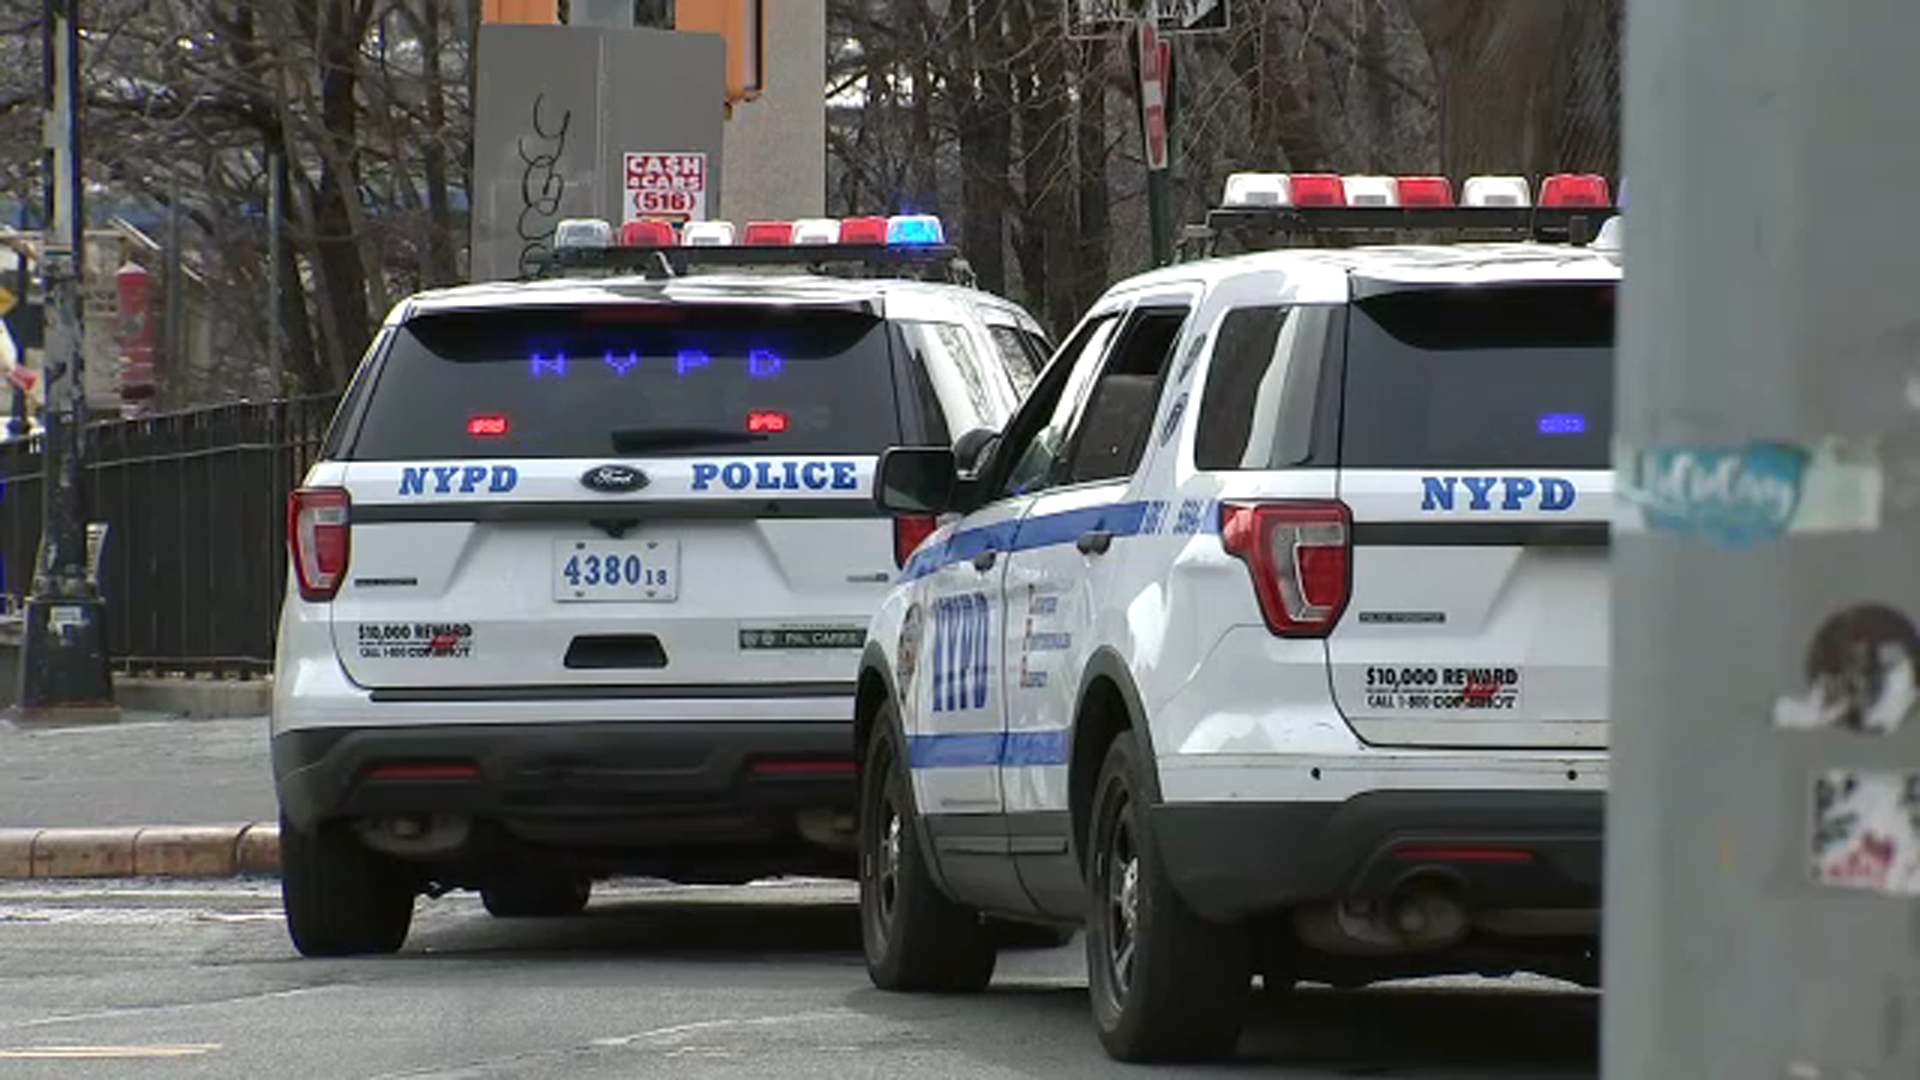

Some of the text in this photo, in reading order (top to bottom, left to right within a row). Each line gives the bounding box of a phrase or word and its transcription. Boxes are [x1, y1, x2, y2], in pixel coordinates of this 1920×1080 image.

[633, 191, 696, 210] (516)
[532, 349, 782, 376] NYPD
[398, 465, 518, 495] NYPD
[691, 461, 857, 490] POLICE
[1420, 476, 1576, 511] NYPD
[564, 555, 668, 585] 4380 18
[932, 591, 988, 712] NYPD
[1366, 667, 1518, 687] $10,000 REWARD
[1367, 696, 1394, 708] CALL
